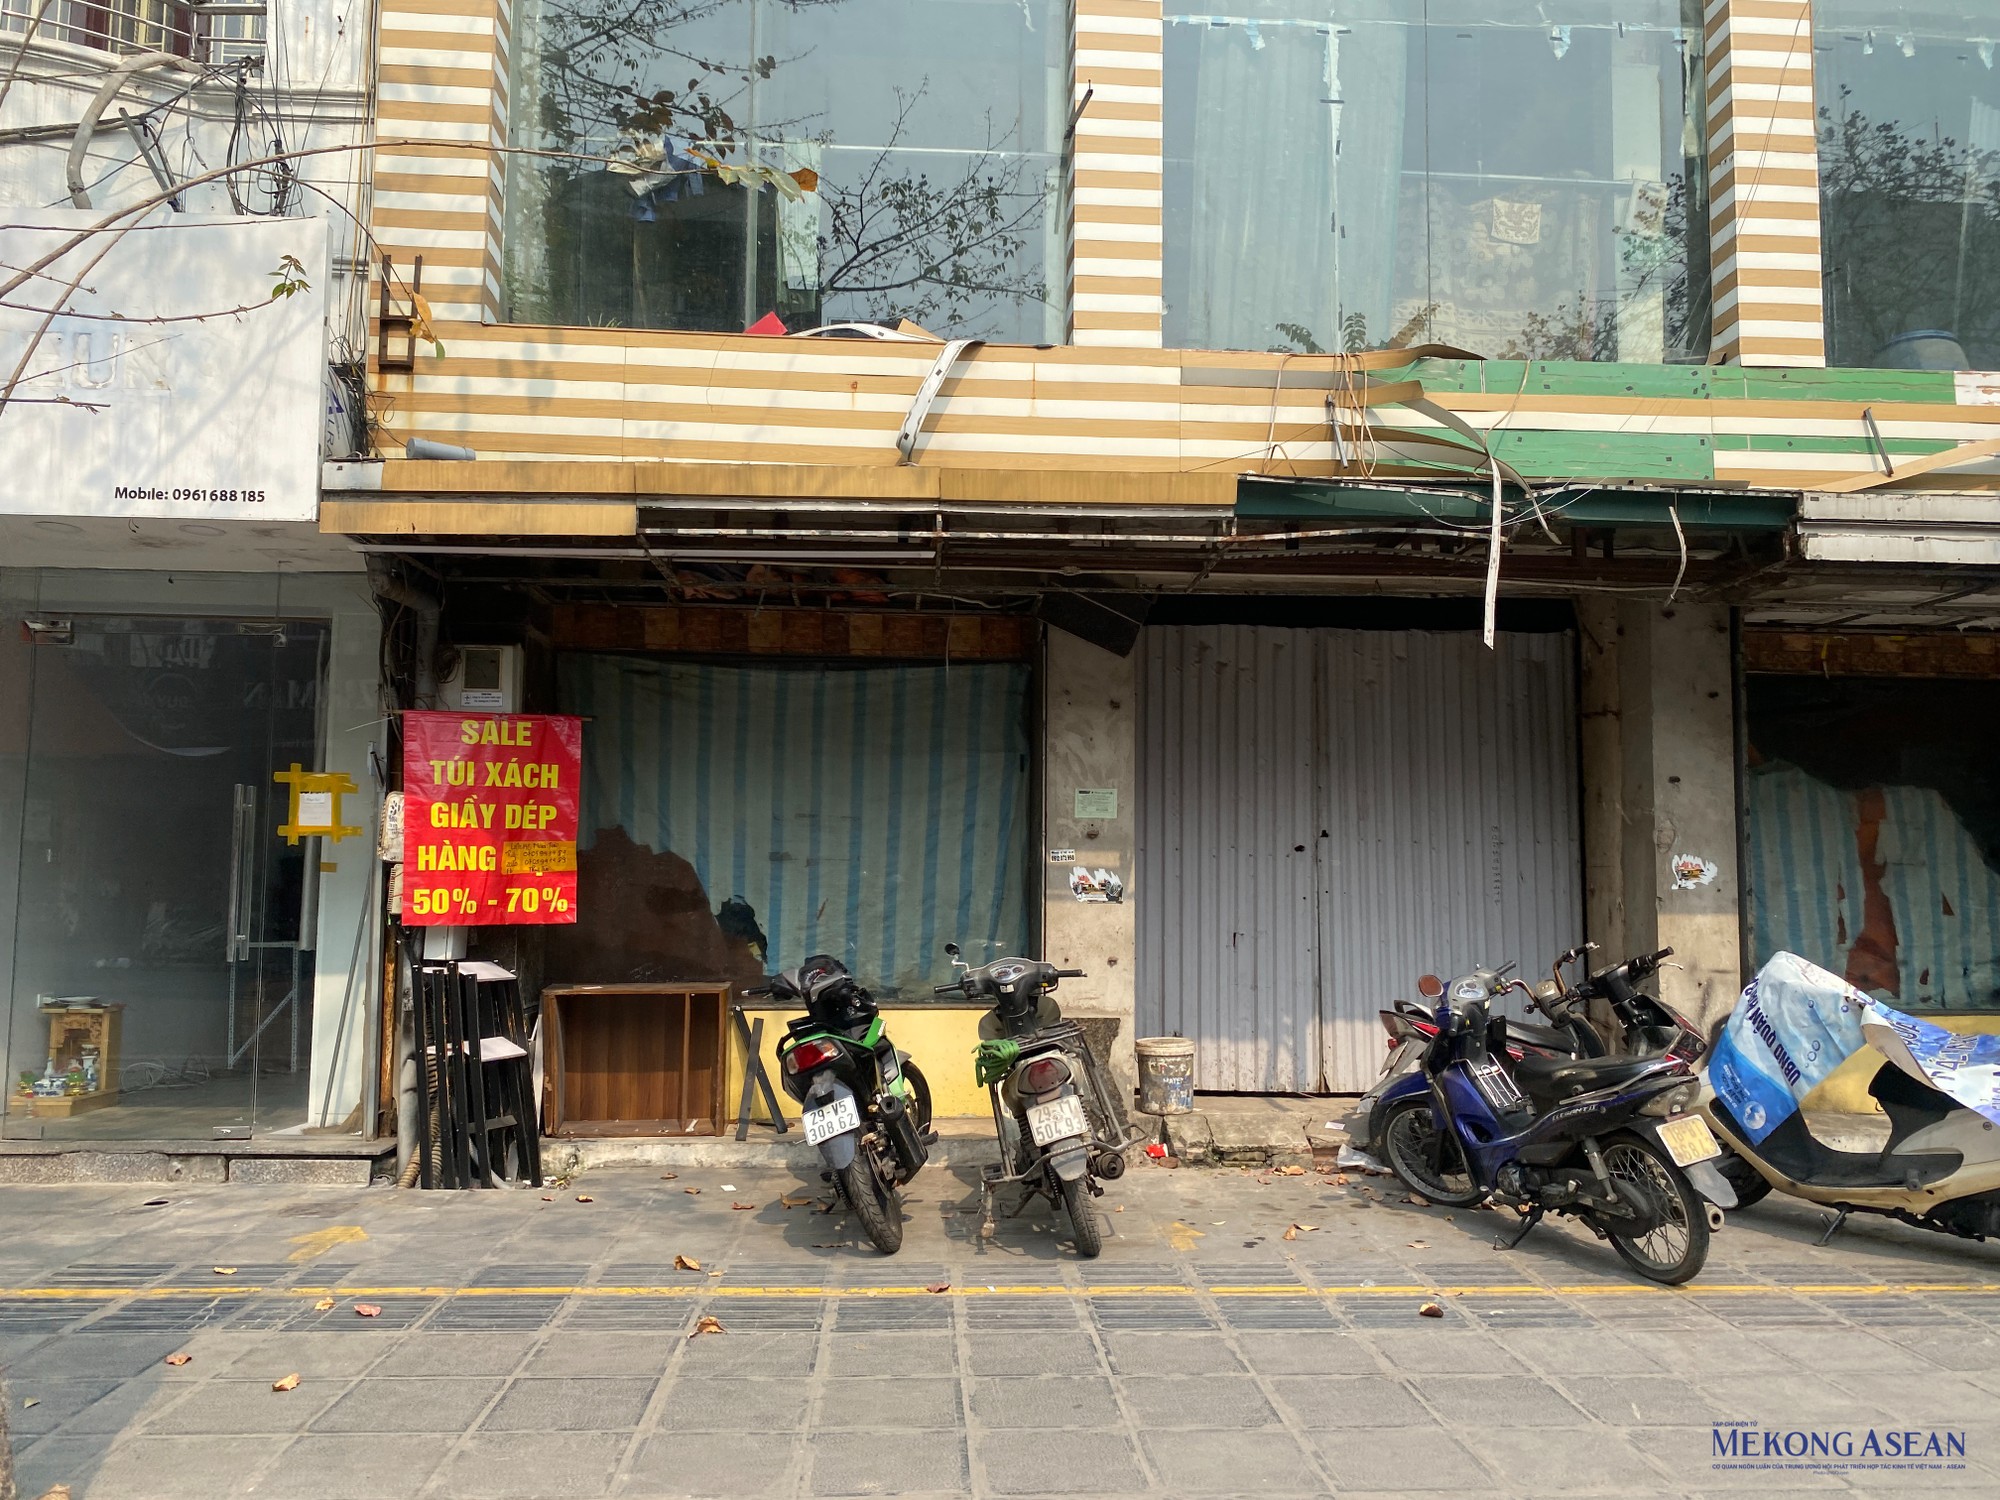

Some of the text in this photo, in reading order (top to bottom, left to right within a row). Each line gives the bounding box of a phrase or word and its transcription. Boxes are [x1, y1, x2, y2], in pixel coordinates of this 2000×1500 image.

[114, 486, 169, 501] Mobile:
[461, 719, 533, 747] SALE
[429, 755, 560, 789] TÚI XÁCH
[430, 795, 497, 829] GIẦY
[505, 799, 558, 830] DÉP
[417, 840, 496, 872] HÀNG
[412, 888, 478, 915] 50%
[505, 886, 569, 915] 70%
[1748, 1006, 1777, 1049] QUẬN
[1773, 1043, 1802, 1087] UBND
[810, 1100, 847, 1126] 29-V5
[1035, 1099, 1073, 1124] 29-T1
[809, 1113, 856, 1142] 308.62
